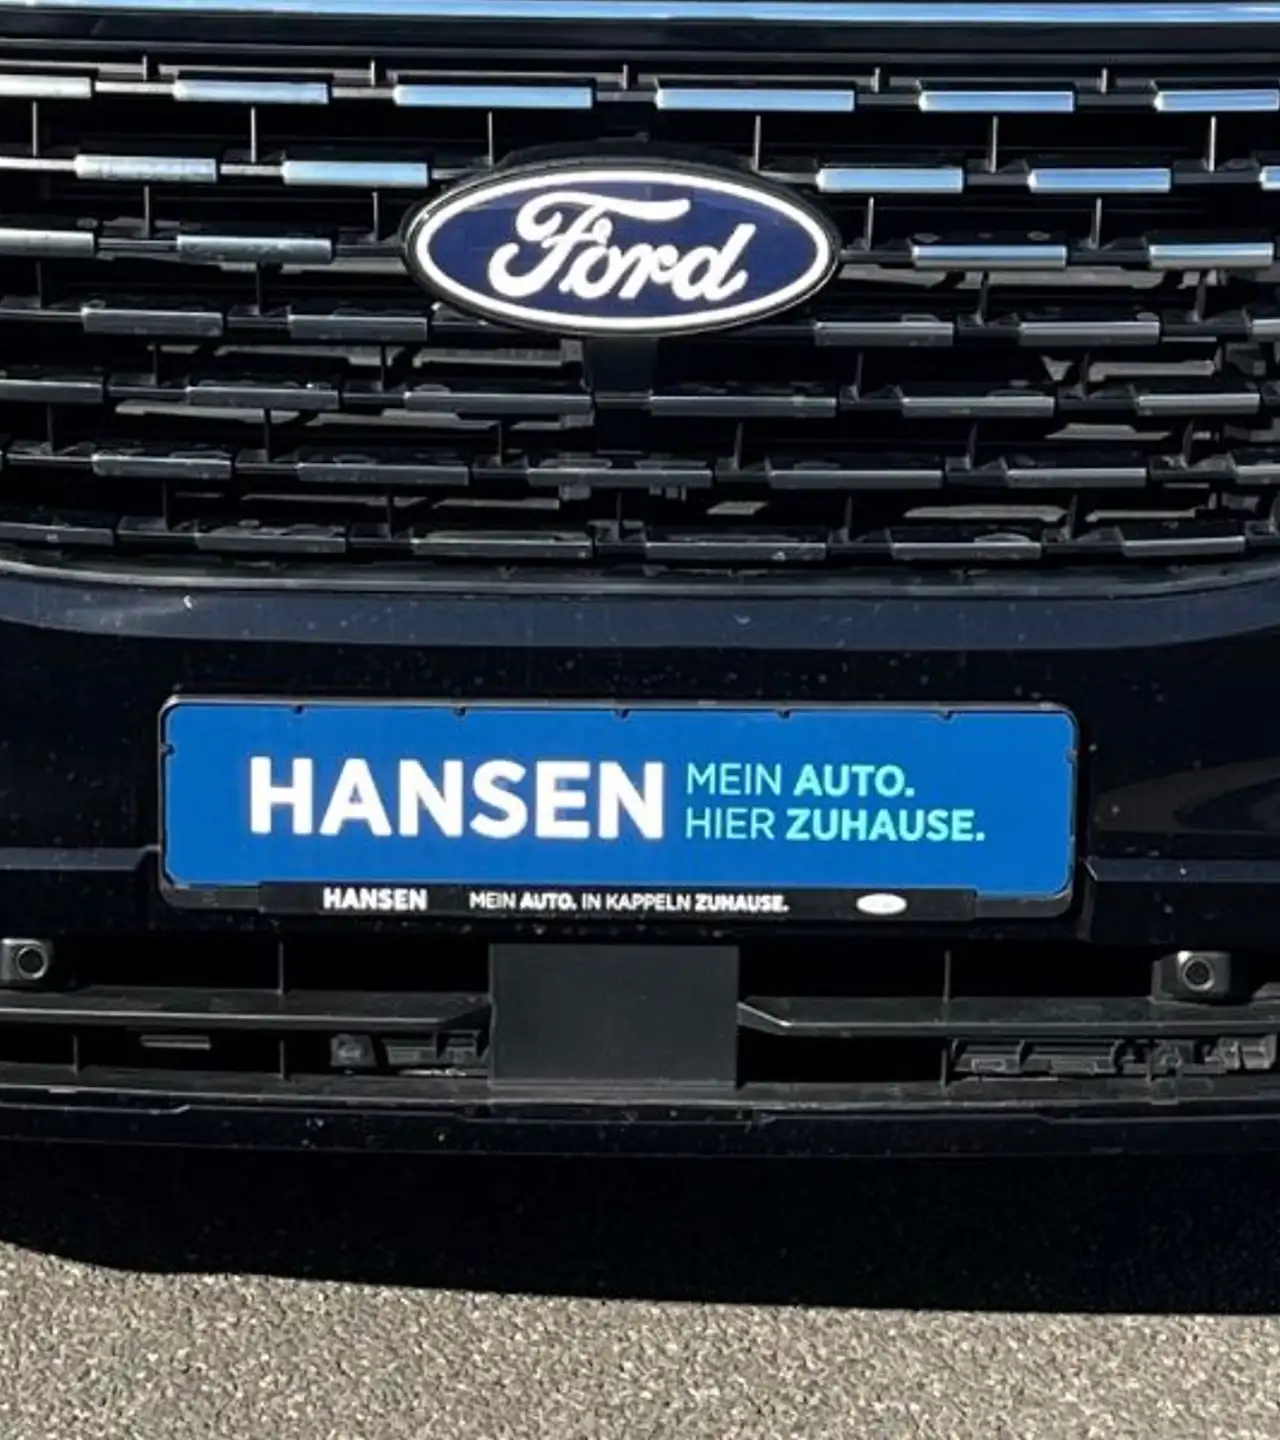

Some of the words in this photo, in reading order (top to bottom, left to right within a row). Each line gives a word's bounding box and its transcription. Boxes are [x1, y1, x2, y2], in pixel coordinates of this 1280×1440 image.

[488, 190, 757, 300] Ford
[250, 756, 664, 840] HANSEN
[686, 762, 782, 796] MEIN
[793, 763, 915, 798] AUTO.
[685, 806, 776, 840] HIER
[785, 807, 986, 842] ZUHAUSE.
[322, 887, 428, 911] HANSEN
[469, 890, 516, 910] MEIN
[520, 891, 578, 911] AUTO.
[582, 891, 602, 911] IN
[605, 891, 692, 912] KAPPELN
[695, 892, 790, 913] ZUHAUSE.
